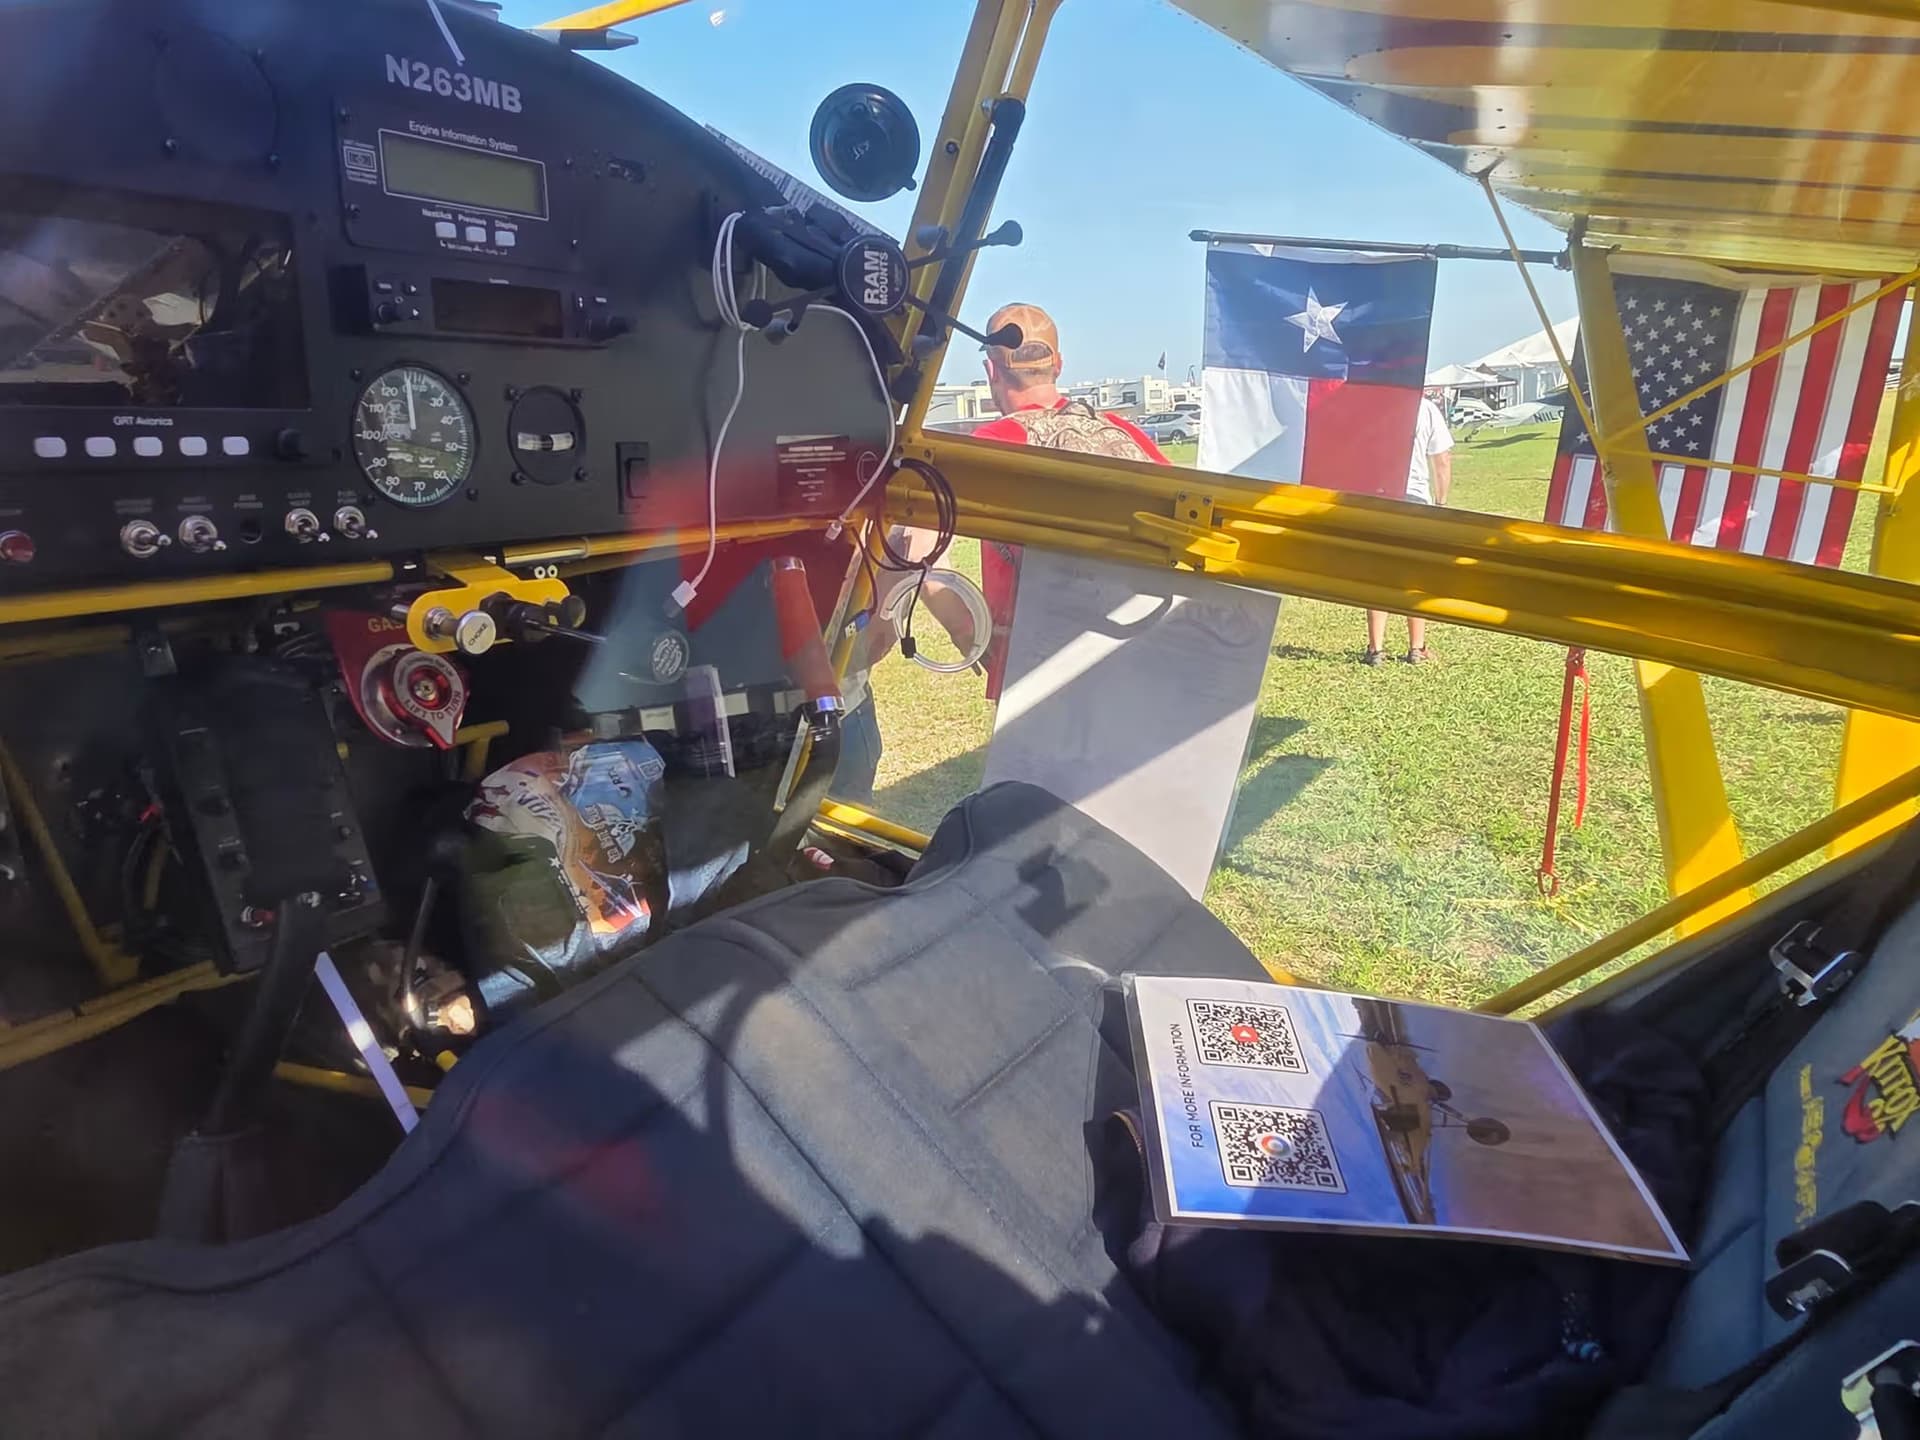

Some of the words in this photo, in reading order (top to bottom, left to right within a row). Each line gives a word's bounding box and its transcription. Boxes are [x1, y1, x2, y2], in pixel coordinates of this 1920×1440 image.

[385, 53, 522, 113] N263MB
[408, 120, 440, 137] Engine
[441, 128, 488, 147] Information
[488, 137, 519, 153] System
[863, 250, 880, 305] RAM
[879, 251, 889, 305] MOUNTS
[381, 387, 399, 397] 120
[430, 397, 444, 408] 30
[368, 403, 385, 413] 110
[135, 416, 174, 426] Avionics
[440, 415, 453, 425] 40
[361, 430, 381, 440] 100
[445, 442, 459, 452] 50
[372, 457, 387, 467] 90
[433, 470, 447, 480] 60
[385, 476, 400, 486] 80
[413, 481, 426, 491] 70
[468, 623, 488, 646] CHOKE
[404, 699, 427, 718] LIFT
[428, 711, 444, 720] TO
[443, 690, 462, 716] TURN
[1170, 1023, 1193, 1088] INFORMATION
[1182, 1090, 1199, 1122] MORE
[1189, 1123, 1204, 1148] FOR
